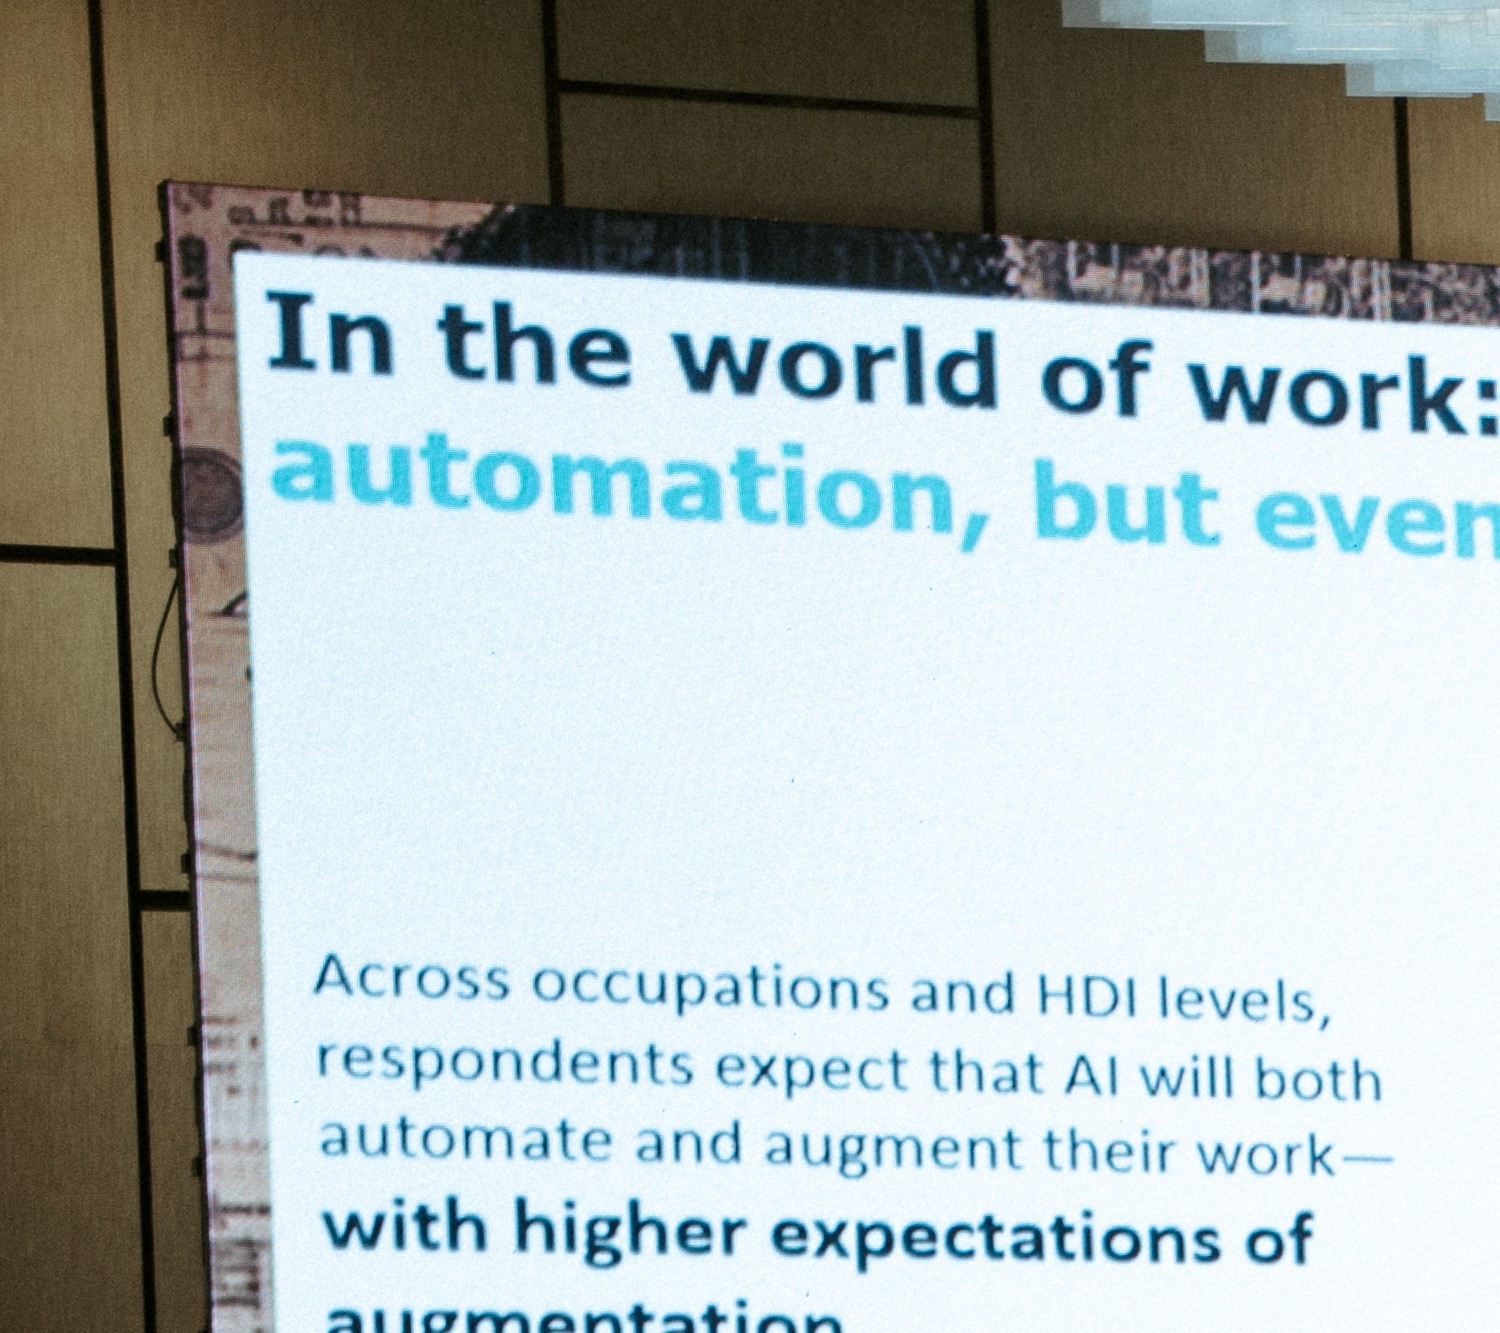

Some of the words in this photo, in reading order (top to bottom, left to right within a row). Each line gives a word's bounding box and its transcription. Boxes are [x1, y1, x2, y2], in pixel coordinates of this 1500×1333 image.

[266, 289, 394, 377] In
[437, 301, 632, 389] the
[672, 325, 999, 411] world
[1041, 339, 1154, 418] of
[1187, 354, 1500, 438] work:
[271, 433, 990, 555] automation,
[1034, 458, 1222, 548] but
[314, 953, 511, 1001] Across
[533, 962, 890, 1018] occupations
[912, 971, 1015, 1015] and
[1040, 974, 1137, 1018] HDI
[1160, 976, 1333, 1032] levels,
[319, 1036, 695, 1093] respondents
[717, 1050, 907, 1100] expect
[931, 1048, 1041, 1095] that
[1066, 1054, 1118, 1097] AI
[1141, 1055, 1234, 1100] will
[1257, 1058, 1382, 1103] both
[321, 1114, 613, 1163] automate
[637, 1119, 742, 1166] and
[766, 1126, 1022, 1180] augment
[1044, 1127, 1175, 1175] their
[322, 1195, 488, 1254] with
[514, 1197, 748, 1270] higher
[772, 1208, 1222, 1274] expectations
[1246, 1209, 1315, 1266] of
